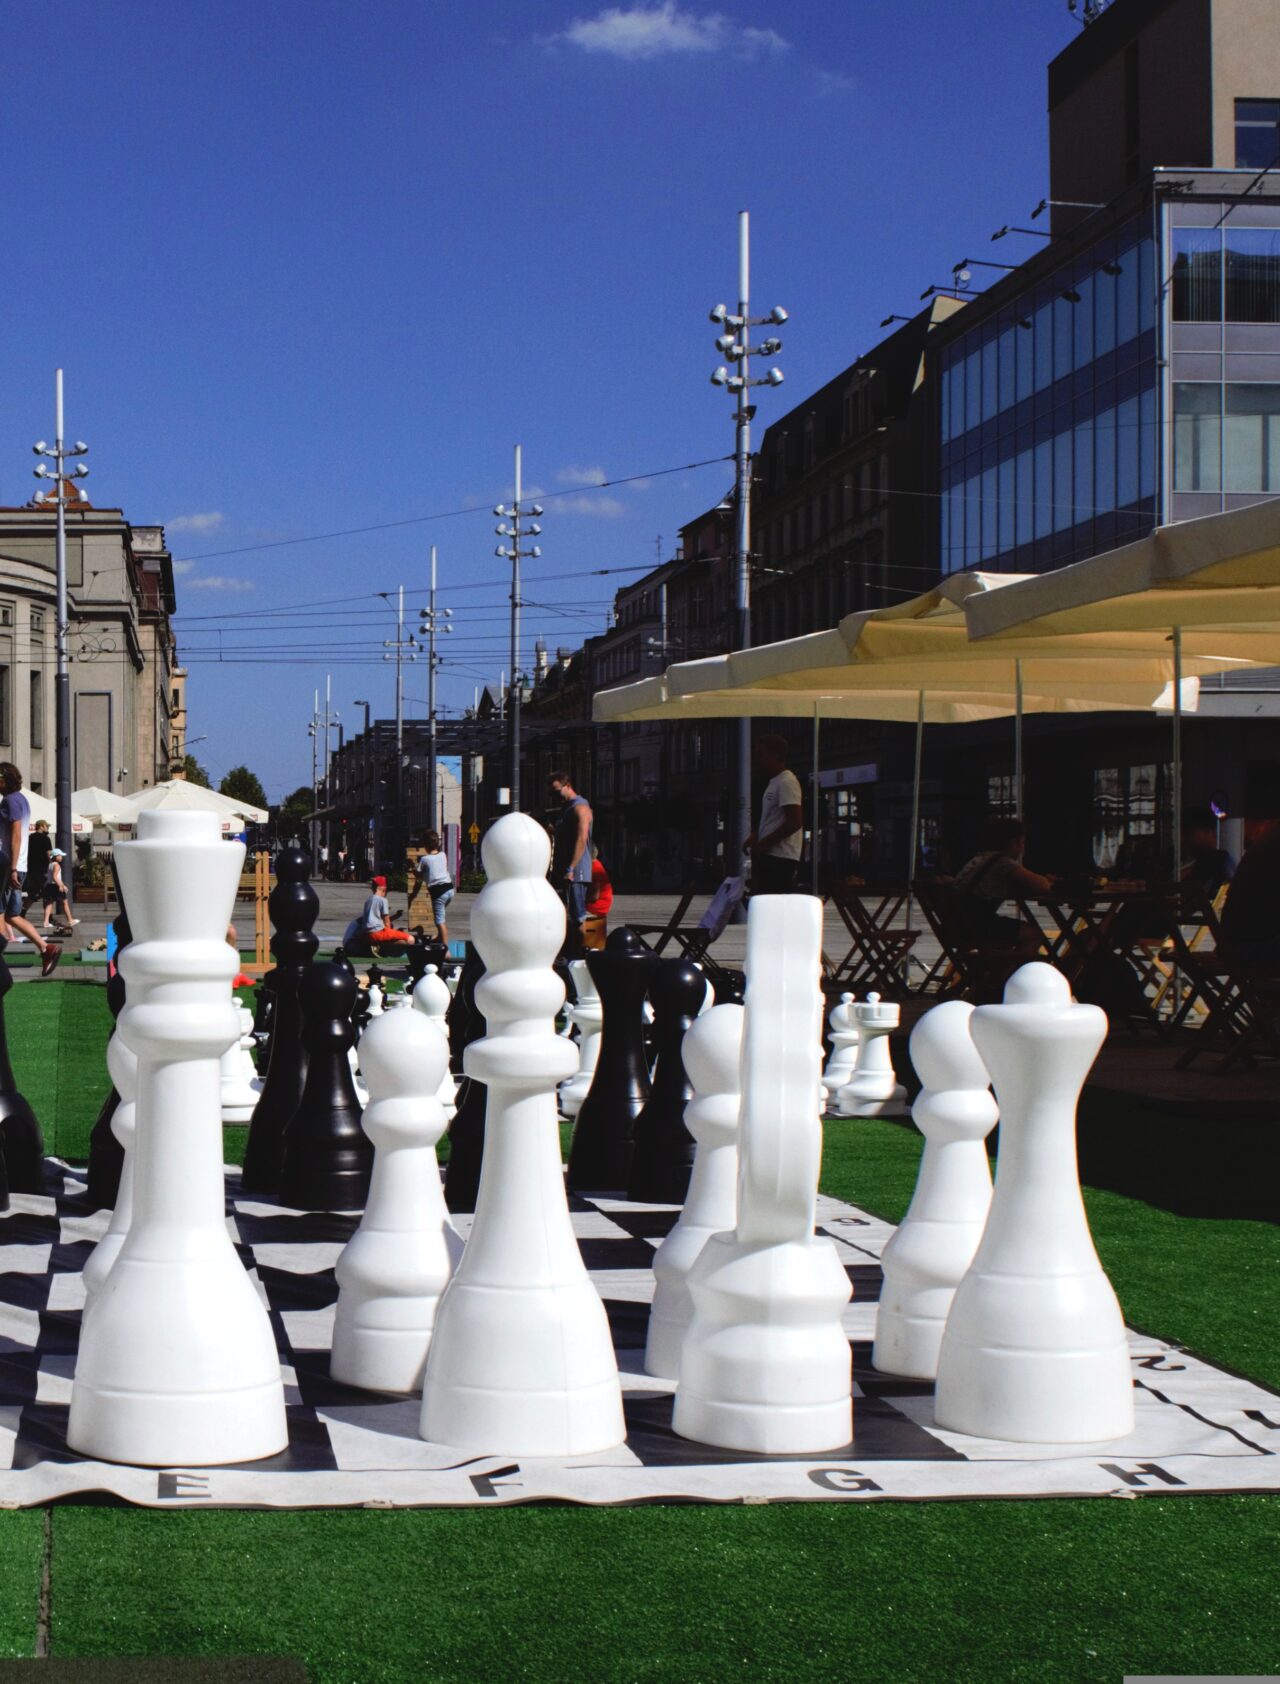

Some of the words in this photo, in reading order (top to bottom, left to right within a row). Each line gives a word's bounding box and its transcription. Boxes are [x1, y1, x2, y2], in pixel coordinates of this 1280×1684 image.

[157, 1472, 212, 1499] E
[468, 1464, 523, 1498] F
[807, 1468, 884, 1492] G
[1097, 1463, 1188, 1486] H
